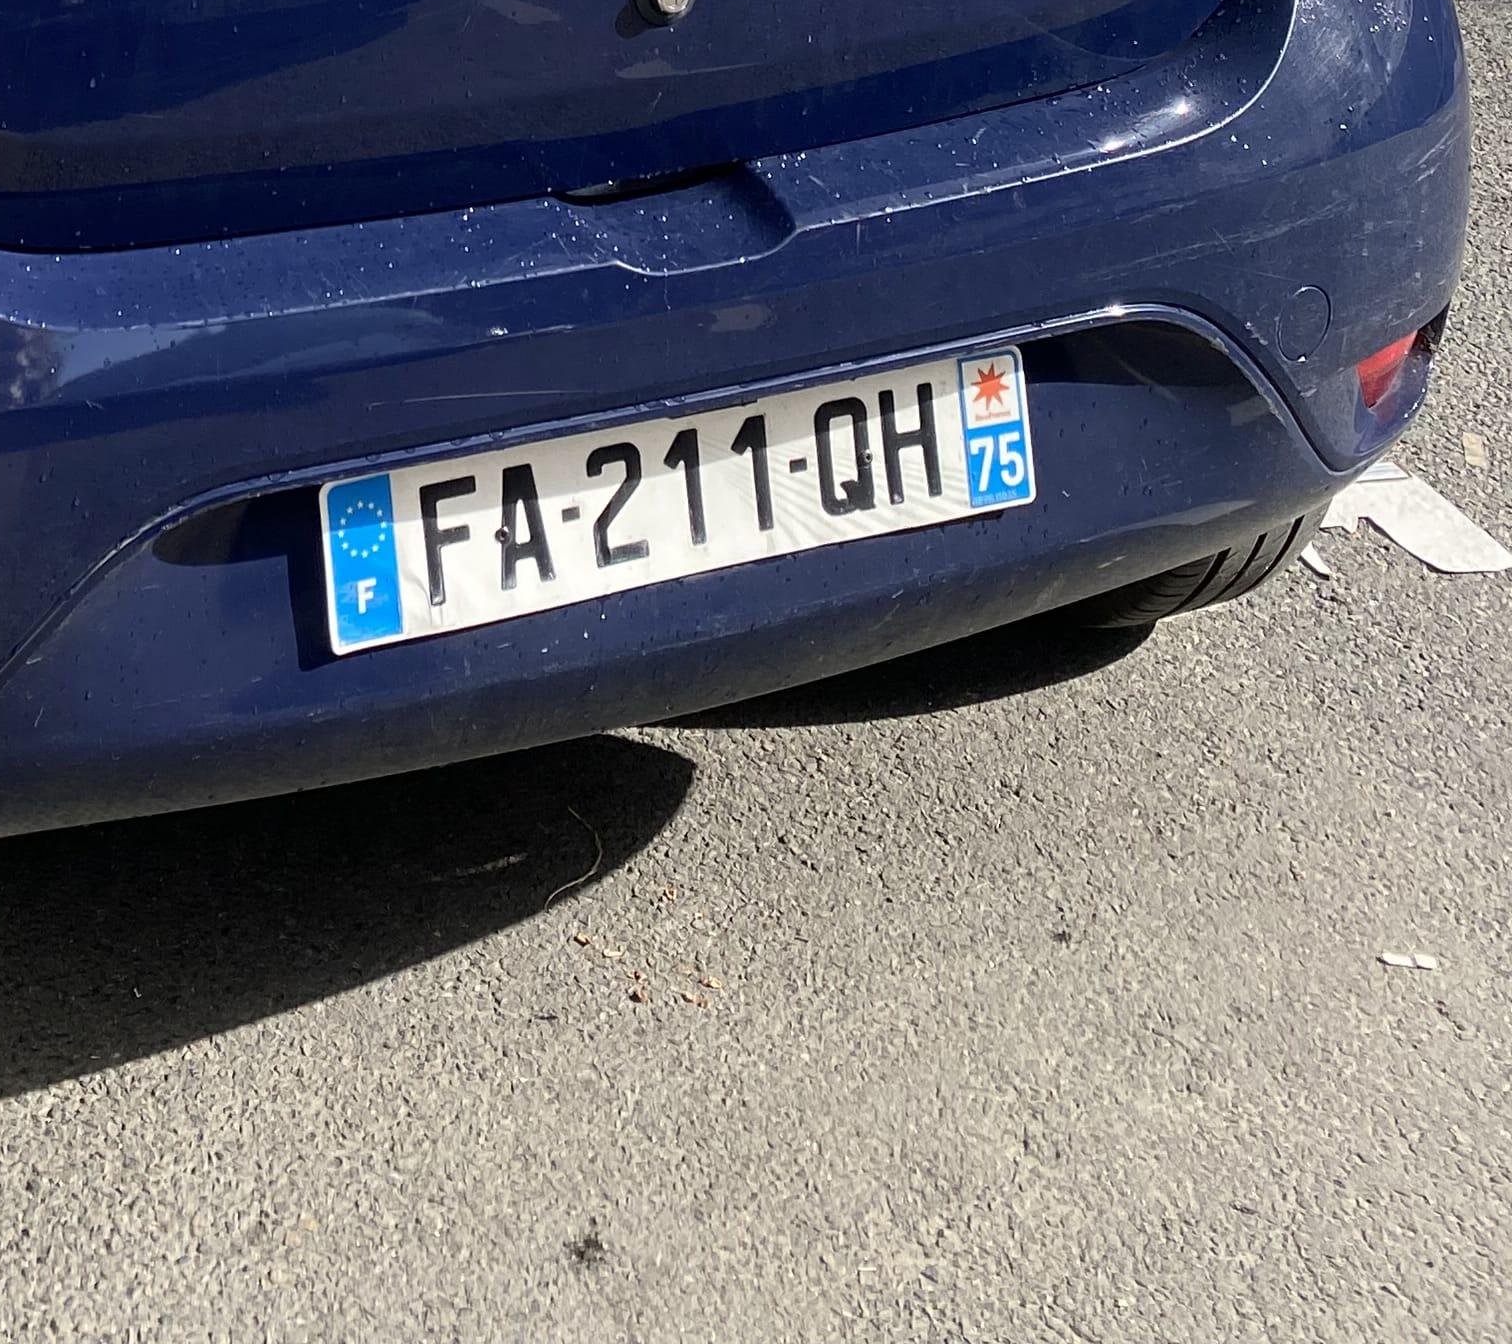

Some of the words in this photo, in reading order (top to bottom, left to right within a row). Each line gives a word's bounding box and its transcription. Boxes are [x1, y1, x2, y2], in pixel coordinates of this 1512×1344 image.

[969, 431, 1025, 492] 75
[418, 382, 944, 607] FA-211-QH
[357, 577, 377, 615] F
